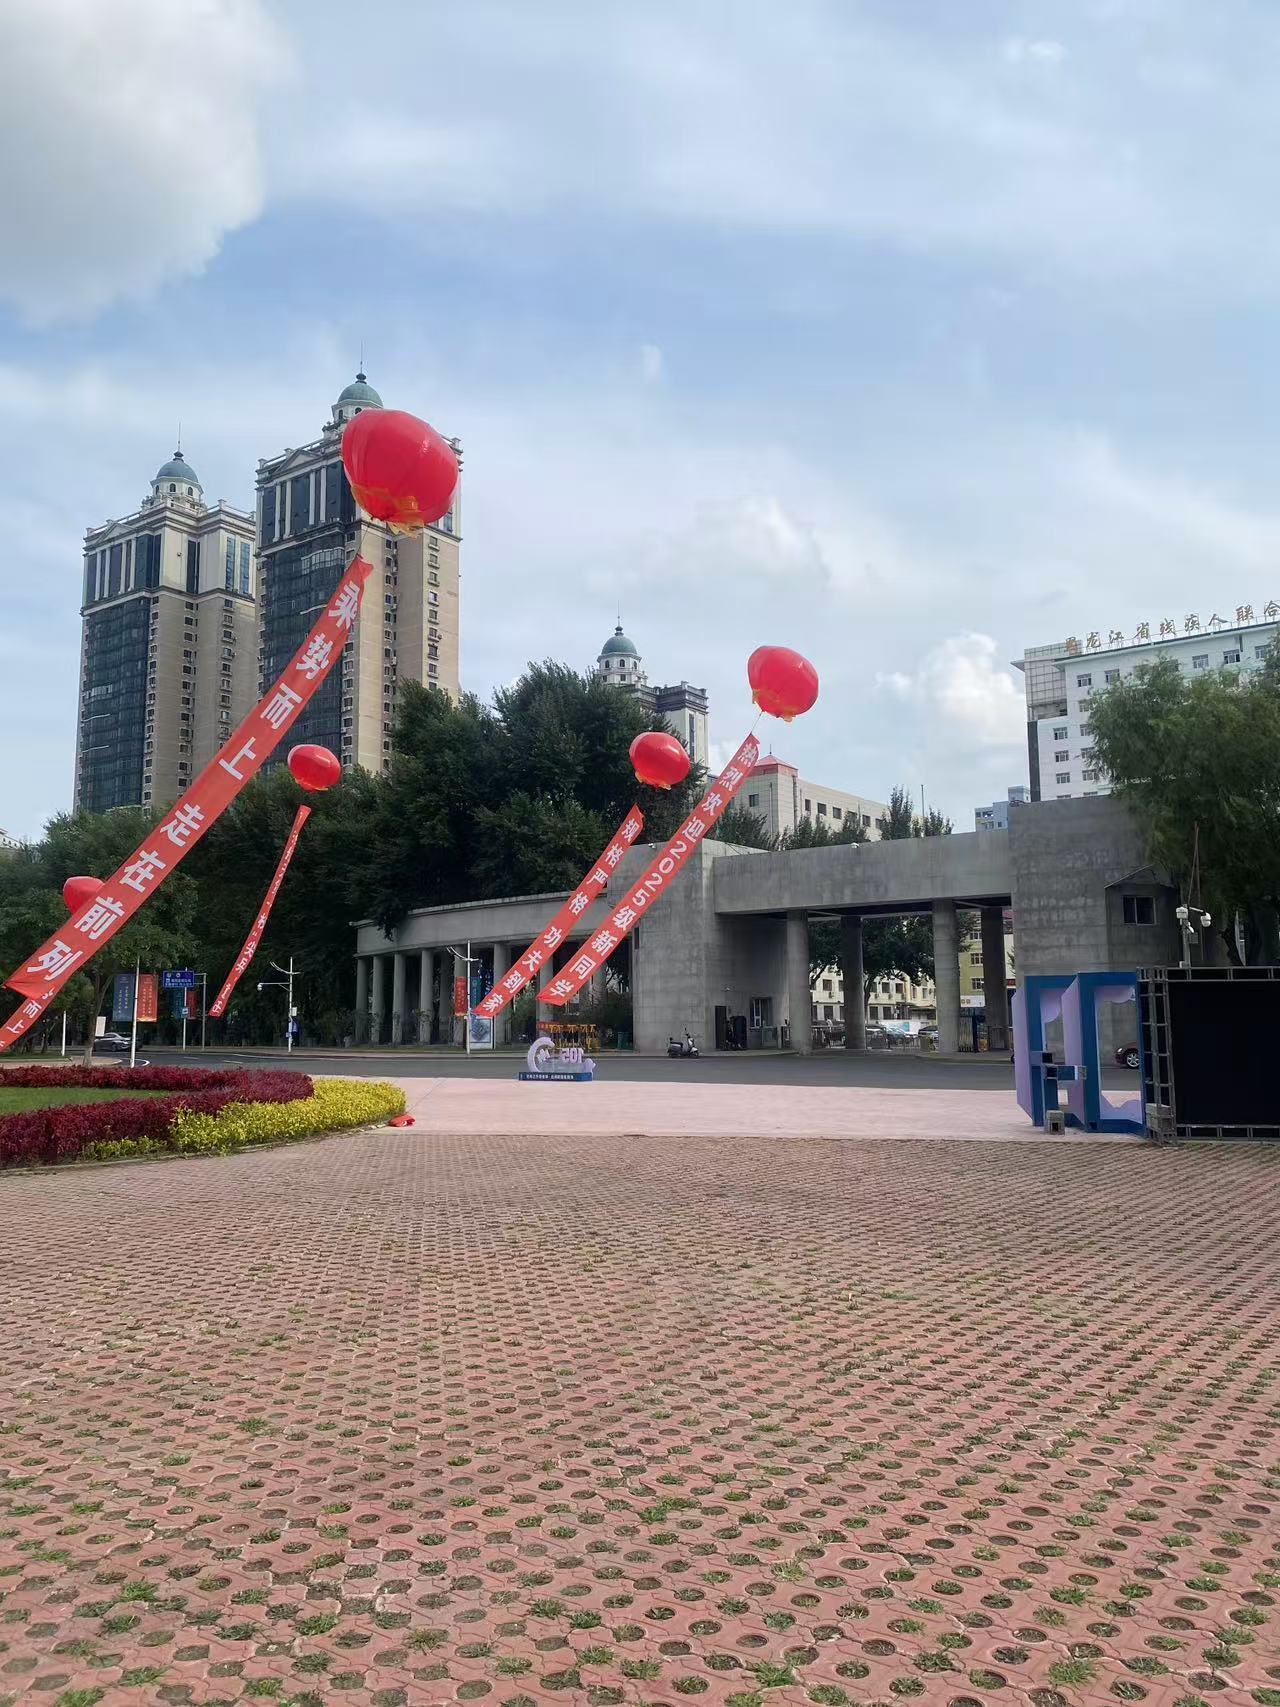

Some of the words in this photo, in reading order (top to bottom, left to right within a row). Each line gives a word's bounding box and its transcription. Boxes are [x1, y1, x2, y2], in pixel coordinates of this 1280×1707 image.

[27, 803, 206, 981] 走在前列
[549, 742, 758, 998] 热烈欢迎2025级新同学
